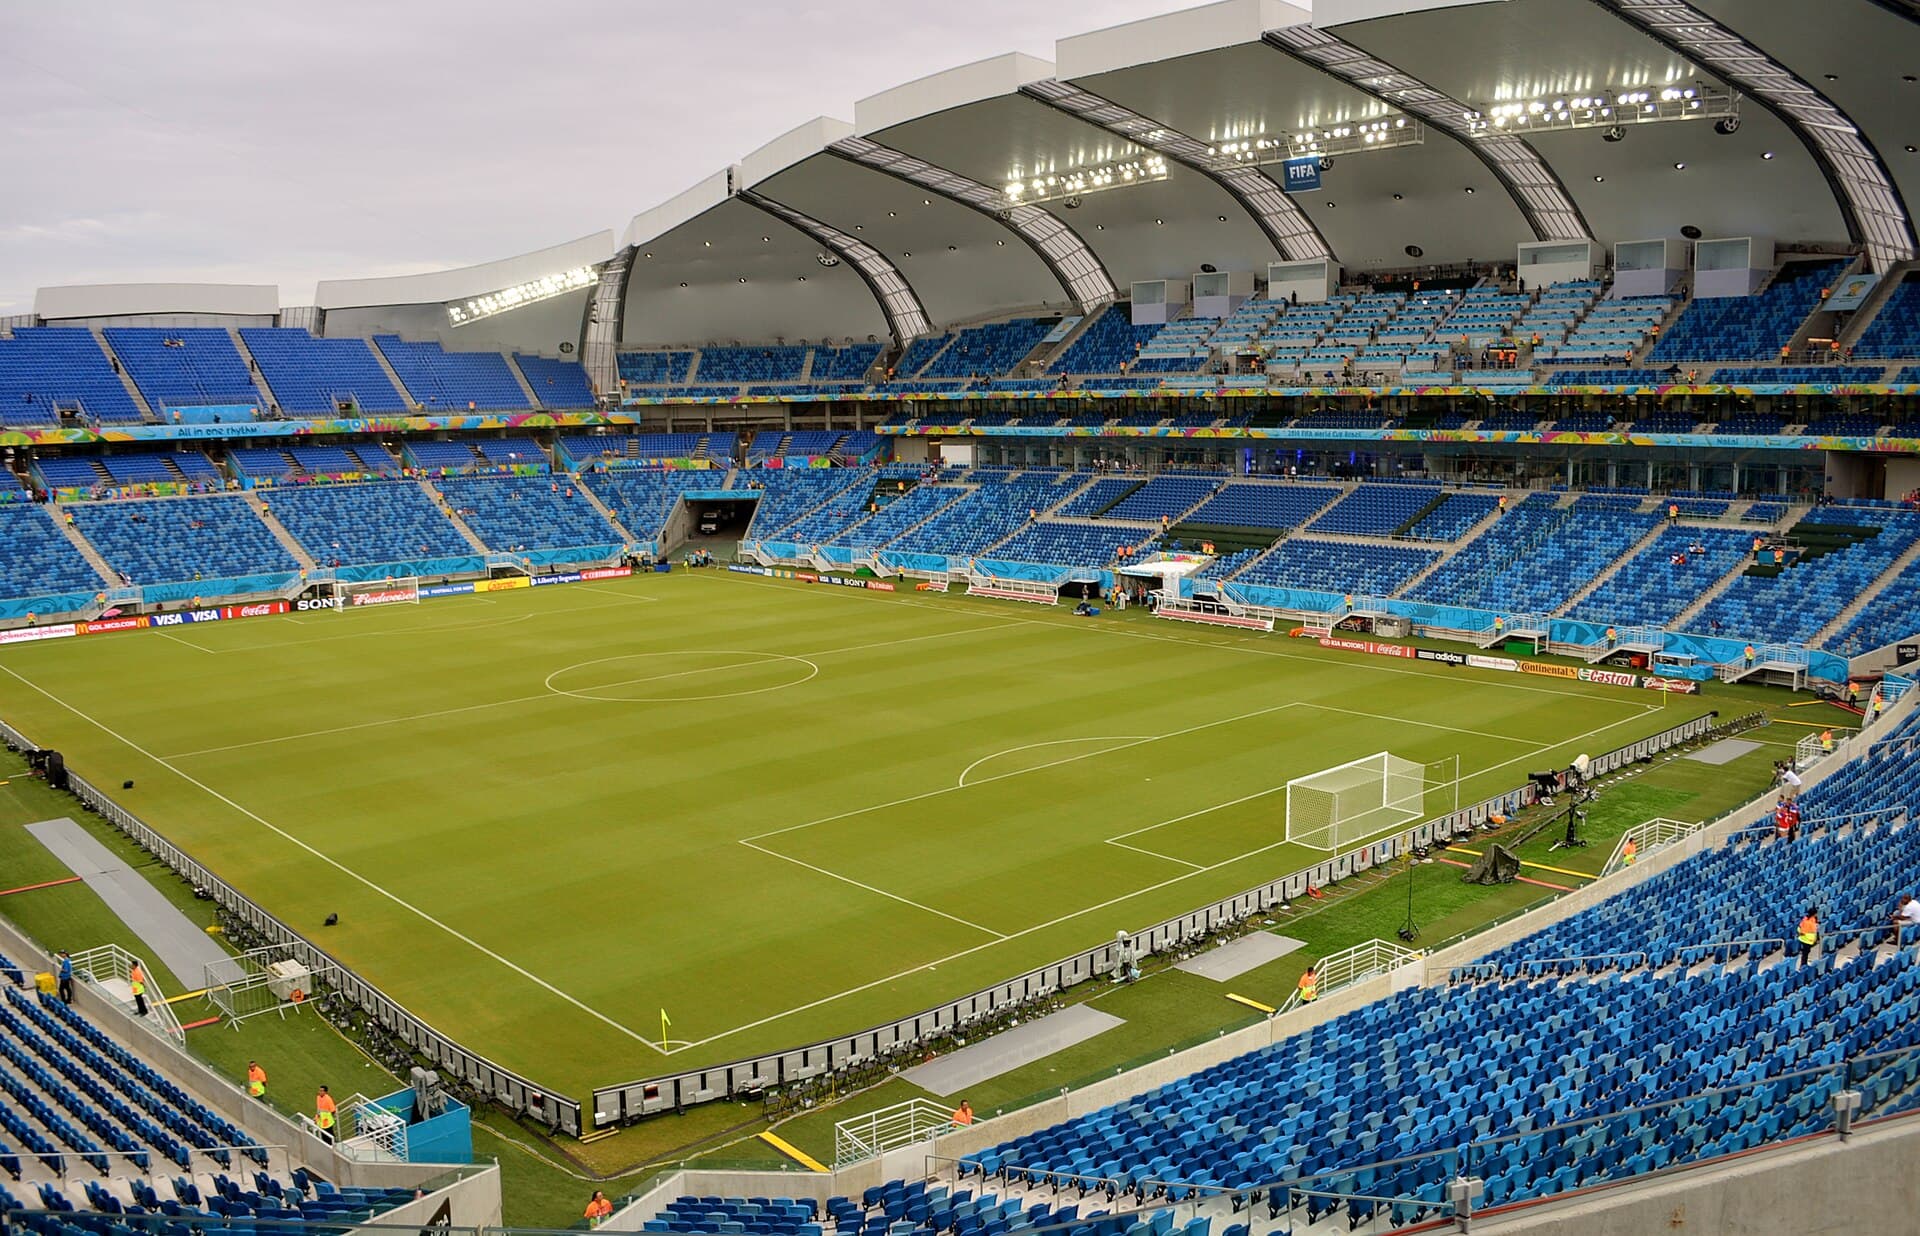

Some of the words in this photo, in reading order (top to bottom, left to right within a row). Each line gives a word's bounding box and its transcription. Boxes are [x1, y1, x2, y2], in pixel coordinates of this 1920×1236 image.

[1289, 163, 1316, 179] FIFA
[178, 428, 191, 437] All
[537, 574, 558, 584] Liberty
[843, 578, 866, 588] SONY
[297, 596, 346, 611] SONY
[352, 591, 416, 606] Budweiser
[154, 613, 183, 626] VISA
[191, 609, 219, 622] VISA
[1435, 652, 1463, 663] adidas
[1521, 662, 1569, 676] Continental
[1590, 670, 1634, 687] Castrol
